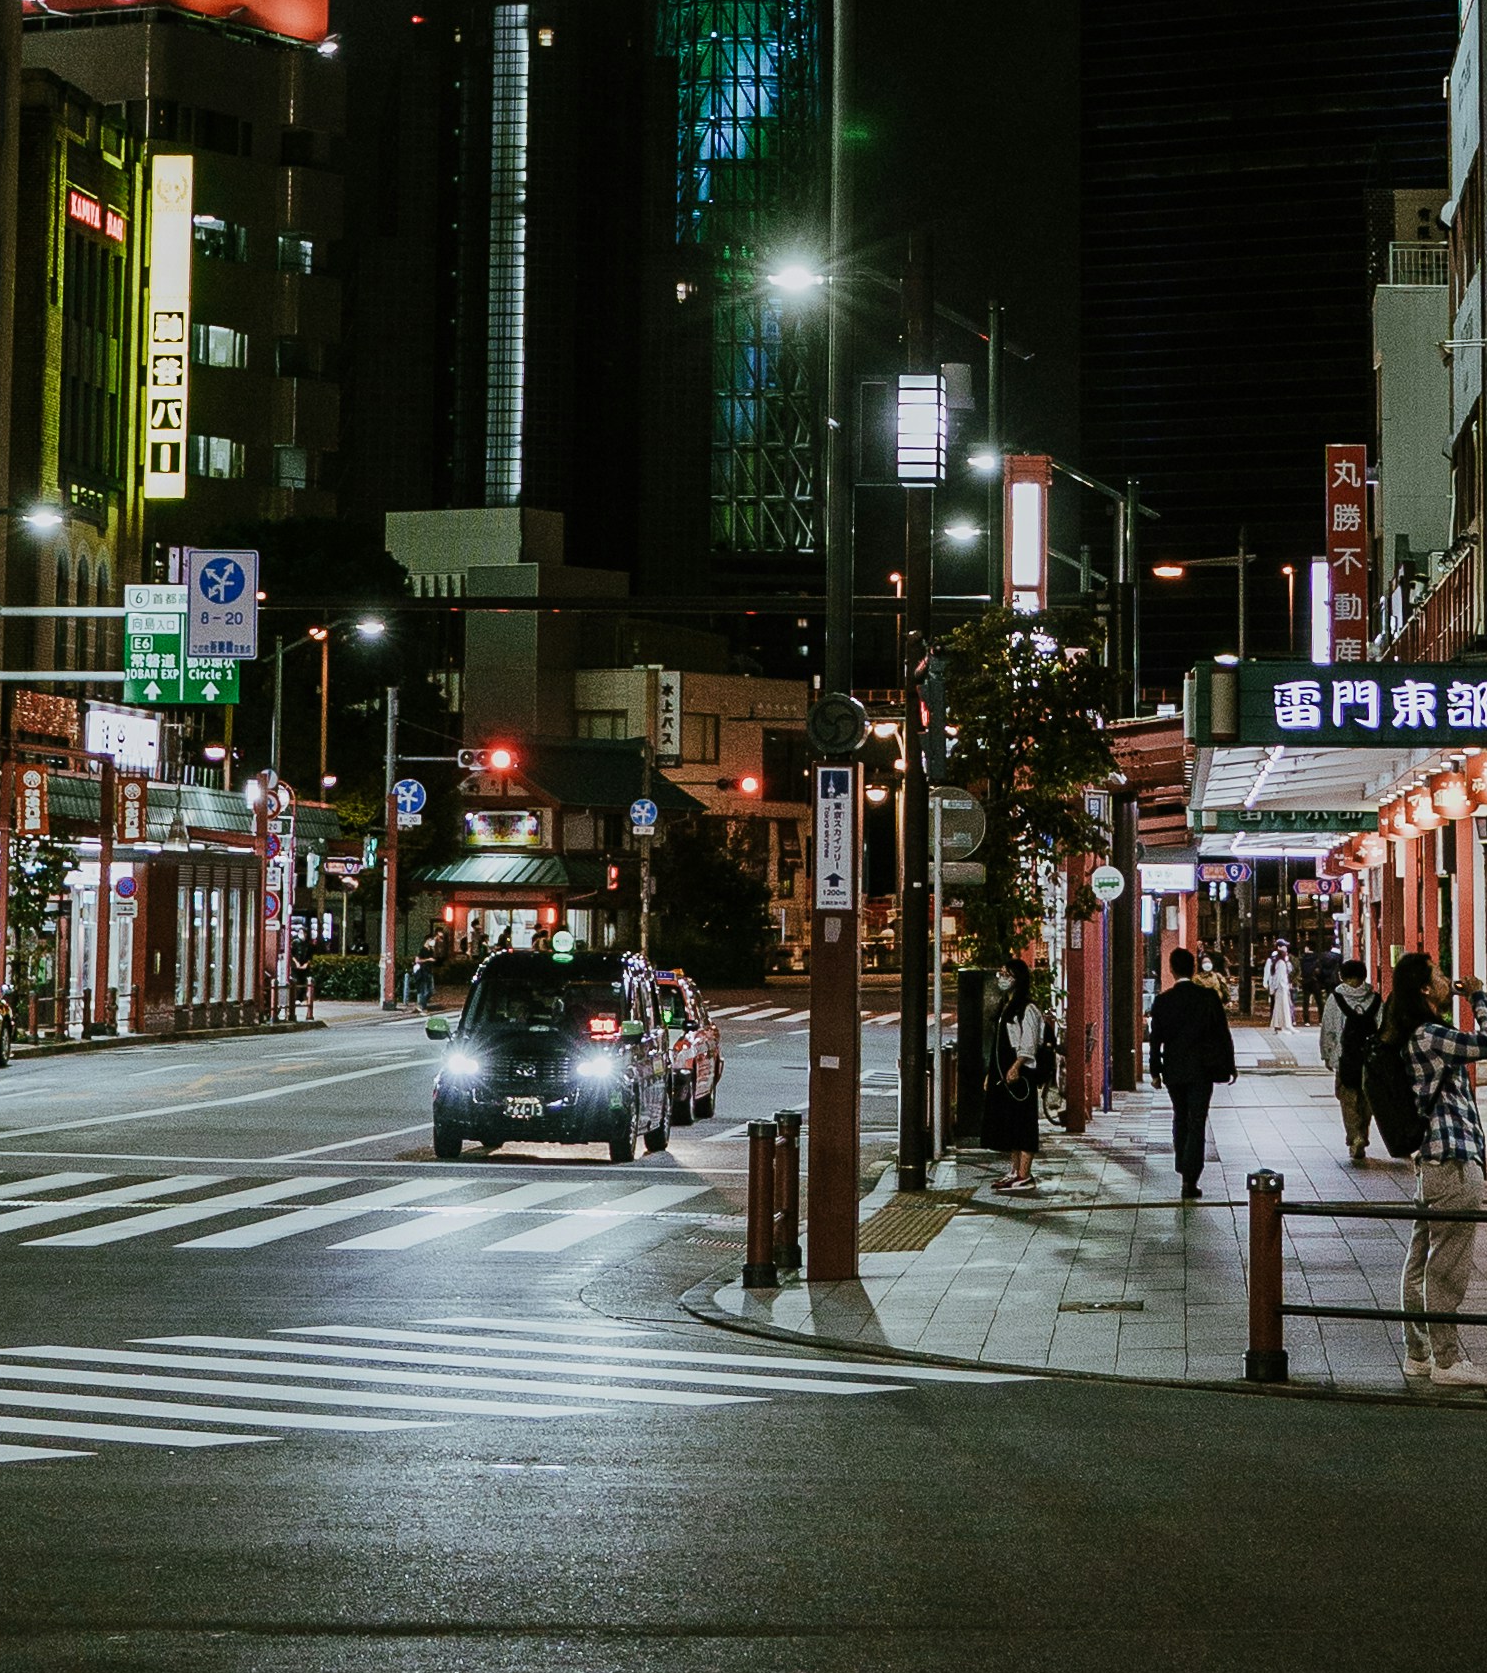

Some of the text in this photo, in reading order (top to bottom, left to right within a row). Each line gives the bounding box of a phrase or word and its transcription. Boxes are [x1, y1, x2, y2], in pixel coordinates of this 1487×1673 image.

[106, 211, 124, 243] BAR
[151, 313, 183, 472] 神谷バー
[1332, 459, 1363, 663] 丸勝不動産
[135, 591, 144, 604] 6
[134, 638, 151, 650] E6
[126, 668, 179, 680] JOBAN EXP
[188, 668, 222, 680] Circle
[662, 683, 674, 746] 水上バス
[833, 802, 843, 870] 東京スカイツリー
[1230, 865, 1238, 877] 6
